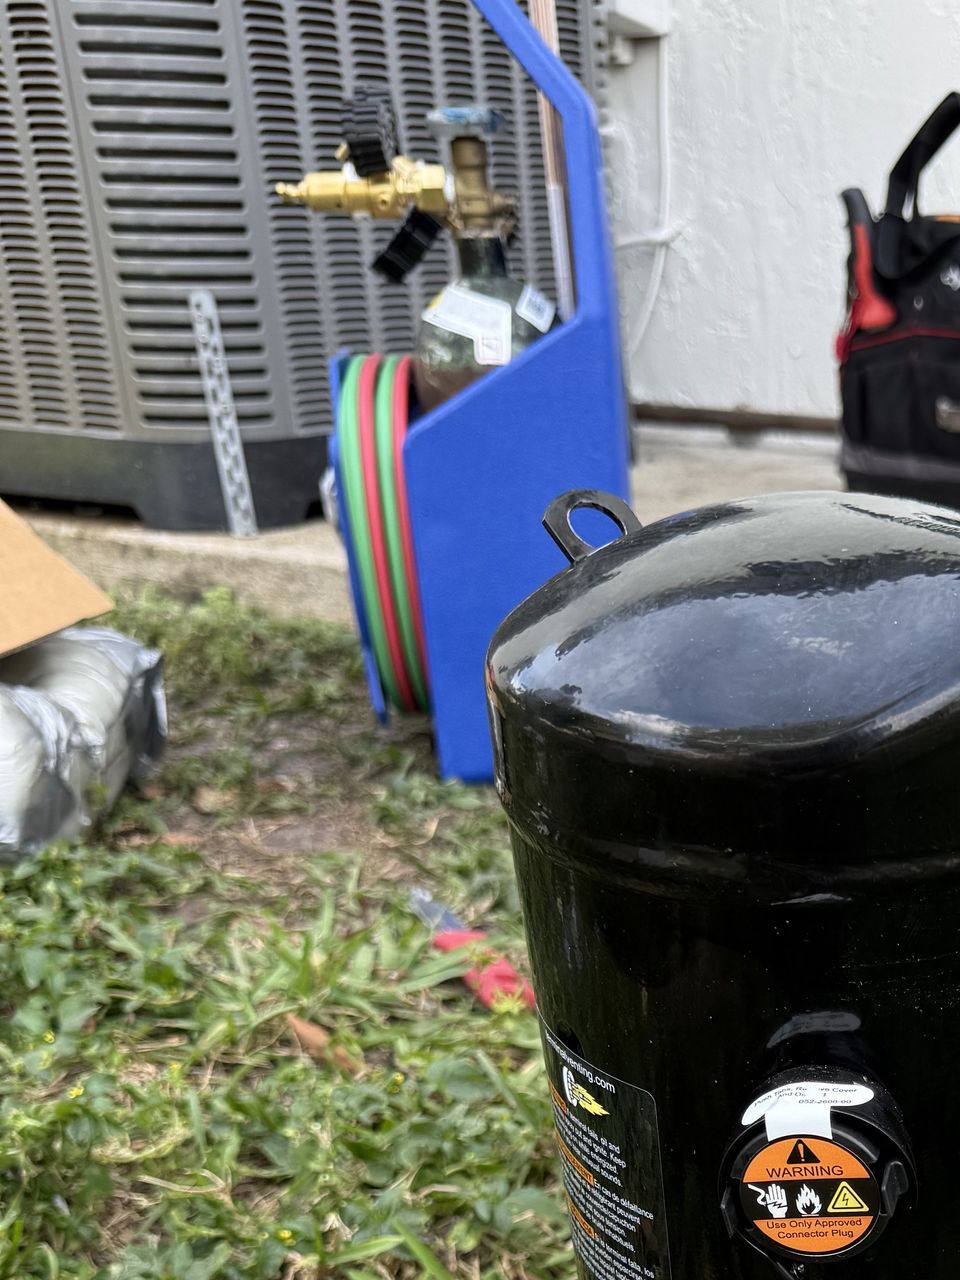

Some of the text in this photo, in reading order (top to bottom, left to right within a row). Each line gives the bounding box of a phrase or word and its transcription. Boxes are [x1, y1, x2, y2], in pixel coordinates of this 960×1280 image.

[609, 1153, 627, 1169] Keep
[766, 1165, 844, 1178] WARNING
[789, 1220, 813, 1230] Only
[814, 1217, 862, 1229] Approved
[777, 1228, 855, 1240] Connector Plug
